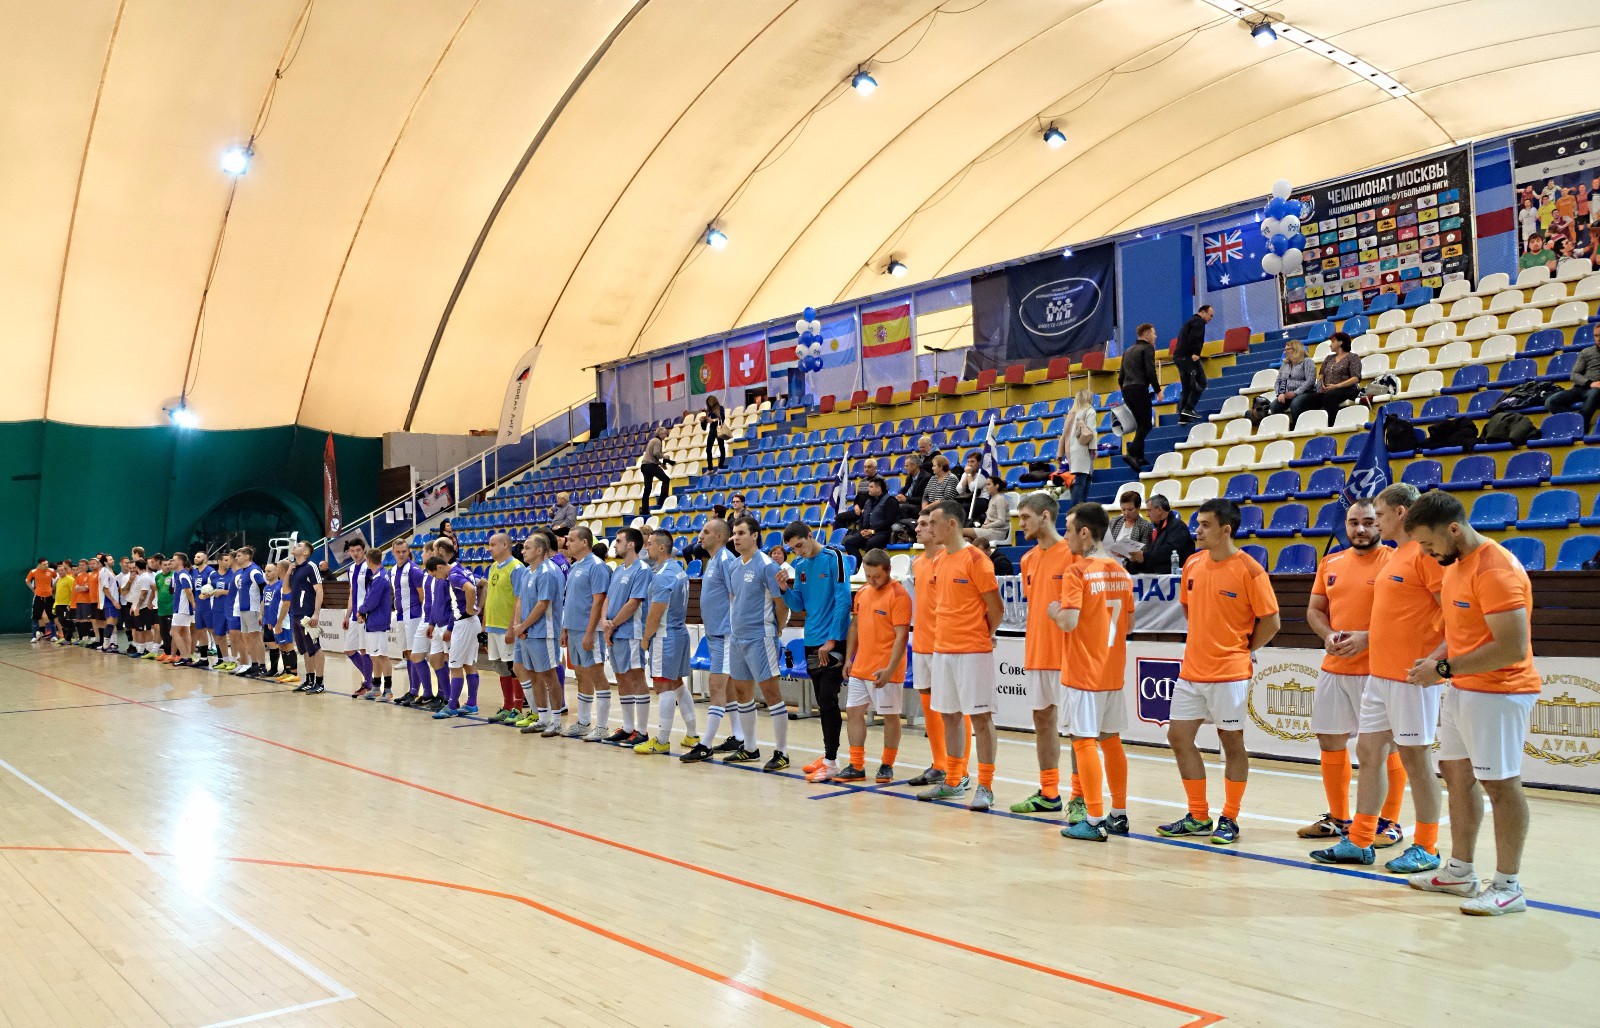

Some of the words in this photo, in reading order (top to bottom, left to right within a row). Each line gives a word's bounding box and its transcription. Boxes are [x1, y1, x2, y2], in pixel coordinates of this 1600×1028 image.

[1327, 175, 1394, 205] ЧЕМПИОНАТ
[1396, 161, 1448, 188] МОСКВЫ
[1328, 198, 1373, 216] НАЦИОНАЛЬНОЙ
[1373, 186, 1431, 206] МИНИ-ФУТБОЛЬНОЙ
[1432, 179, 1449, 192] ЛИГИ
[1105, 598, 1122, 648] 7
[996, 683, 1027, 696] ссийс
[1140, 676, 1176, 701] СФ
[1275, 717, 1311, 731] ДУМА
[1541, 738, 1590, 754] ДУМА
